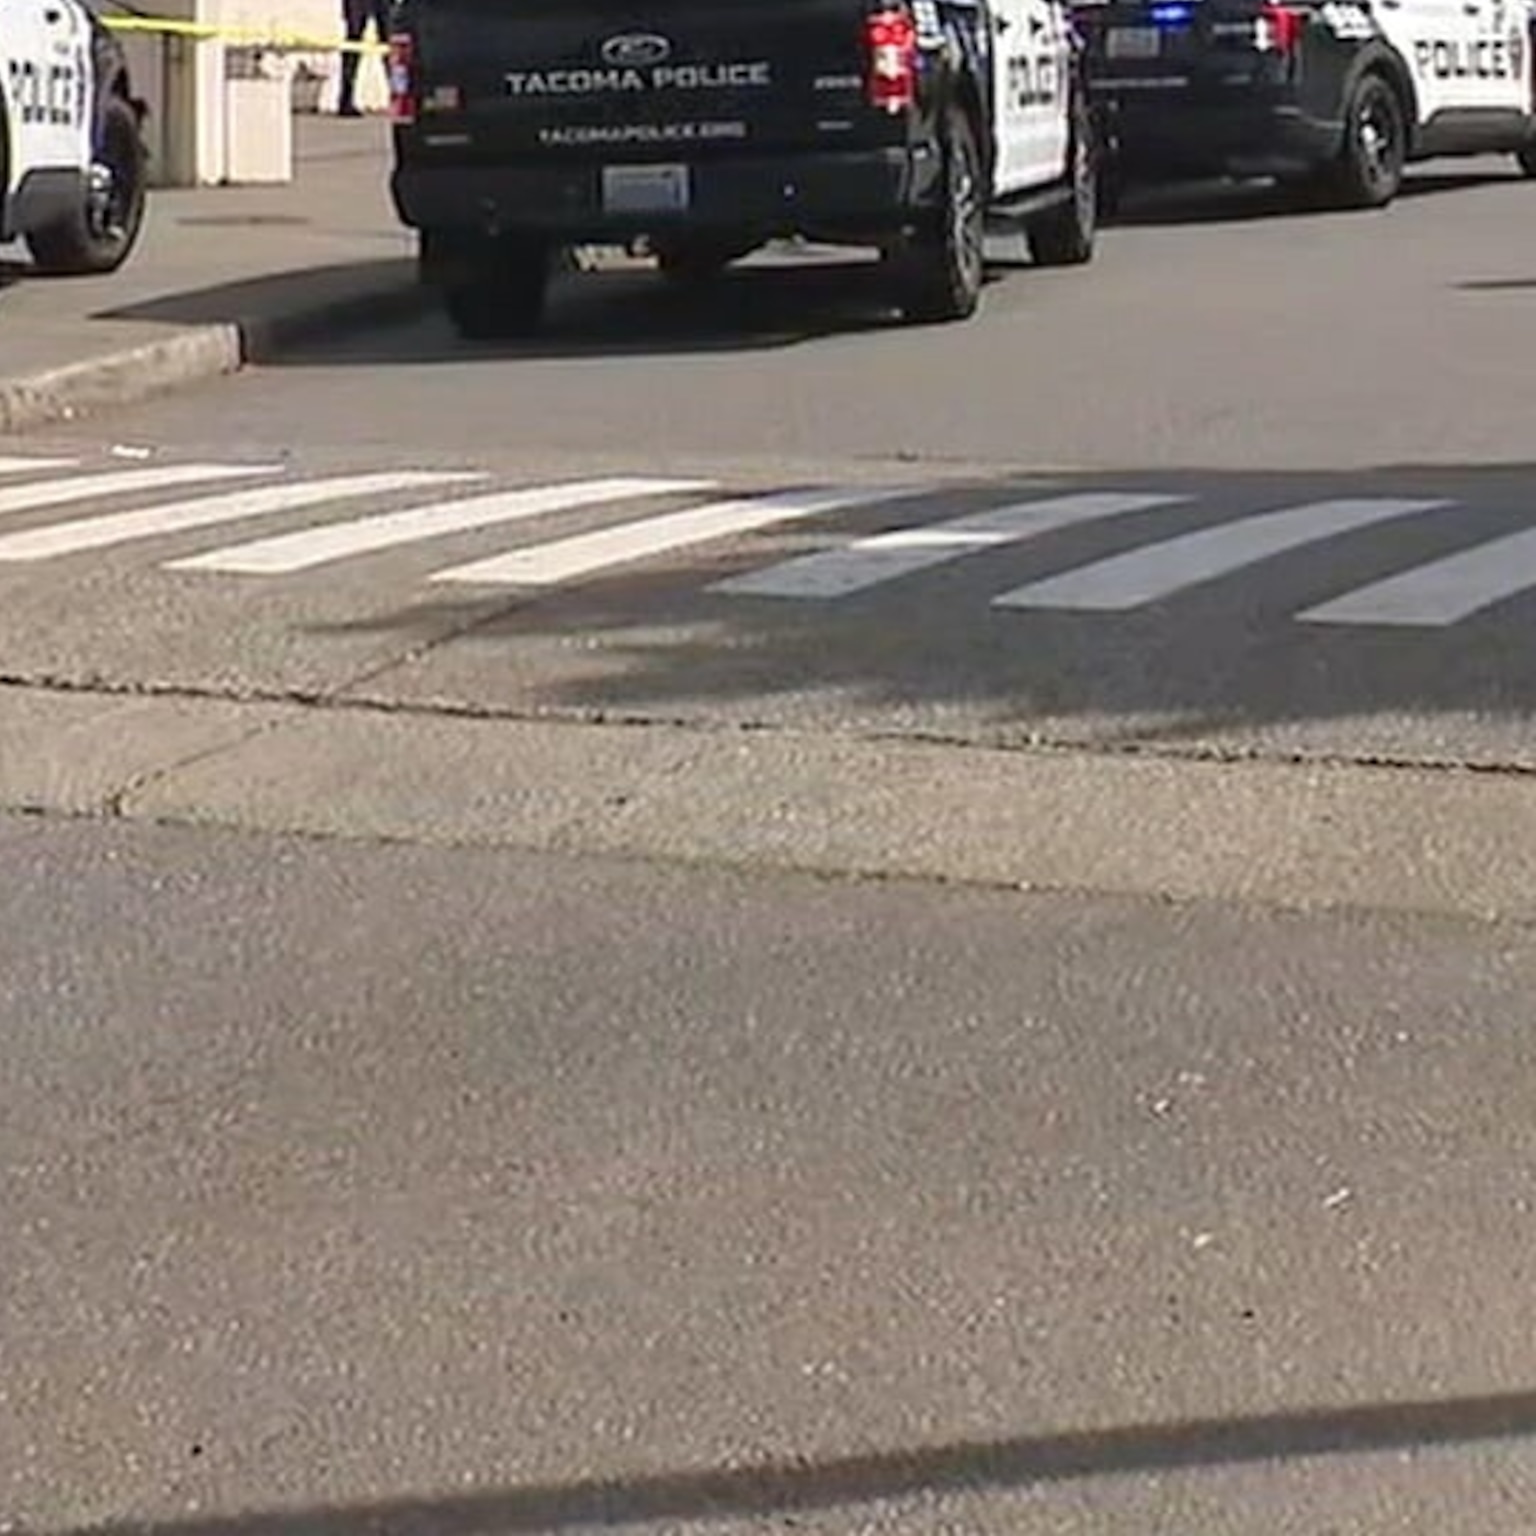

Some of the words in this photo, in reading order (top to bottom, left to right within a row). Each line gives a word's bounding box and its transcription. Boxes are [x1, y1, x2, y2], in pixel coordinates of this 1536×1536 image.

[1414, 39, 1506, 79] POLICE
[505, 67, 645, 96] TACOMA
[652, 62, 770, 89] POLICE
